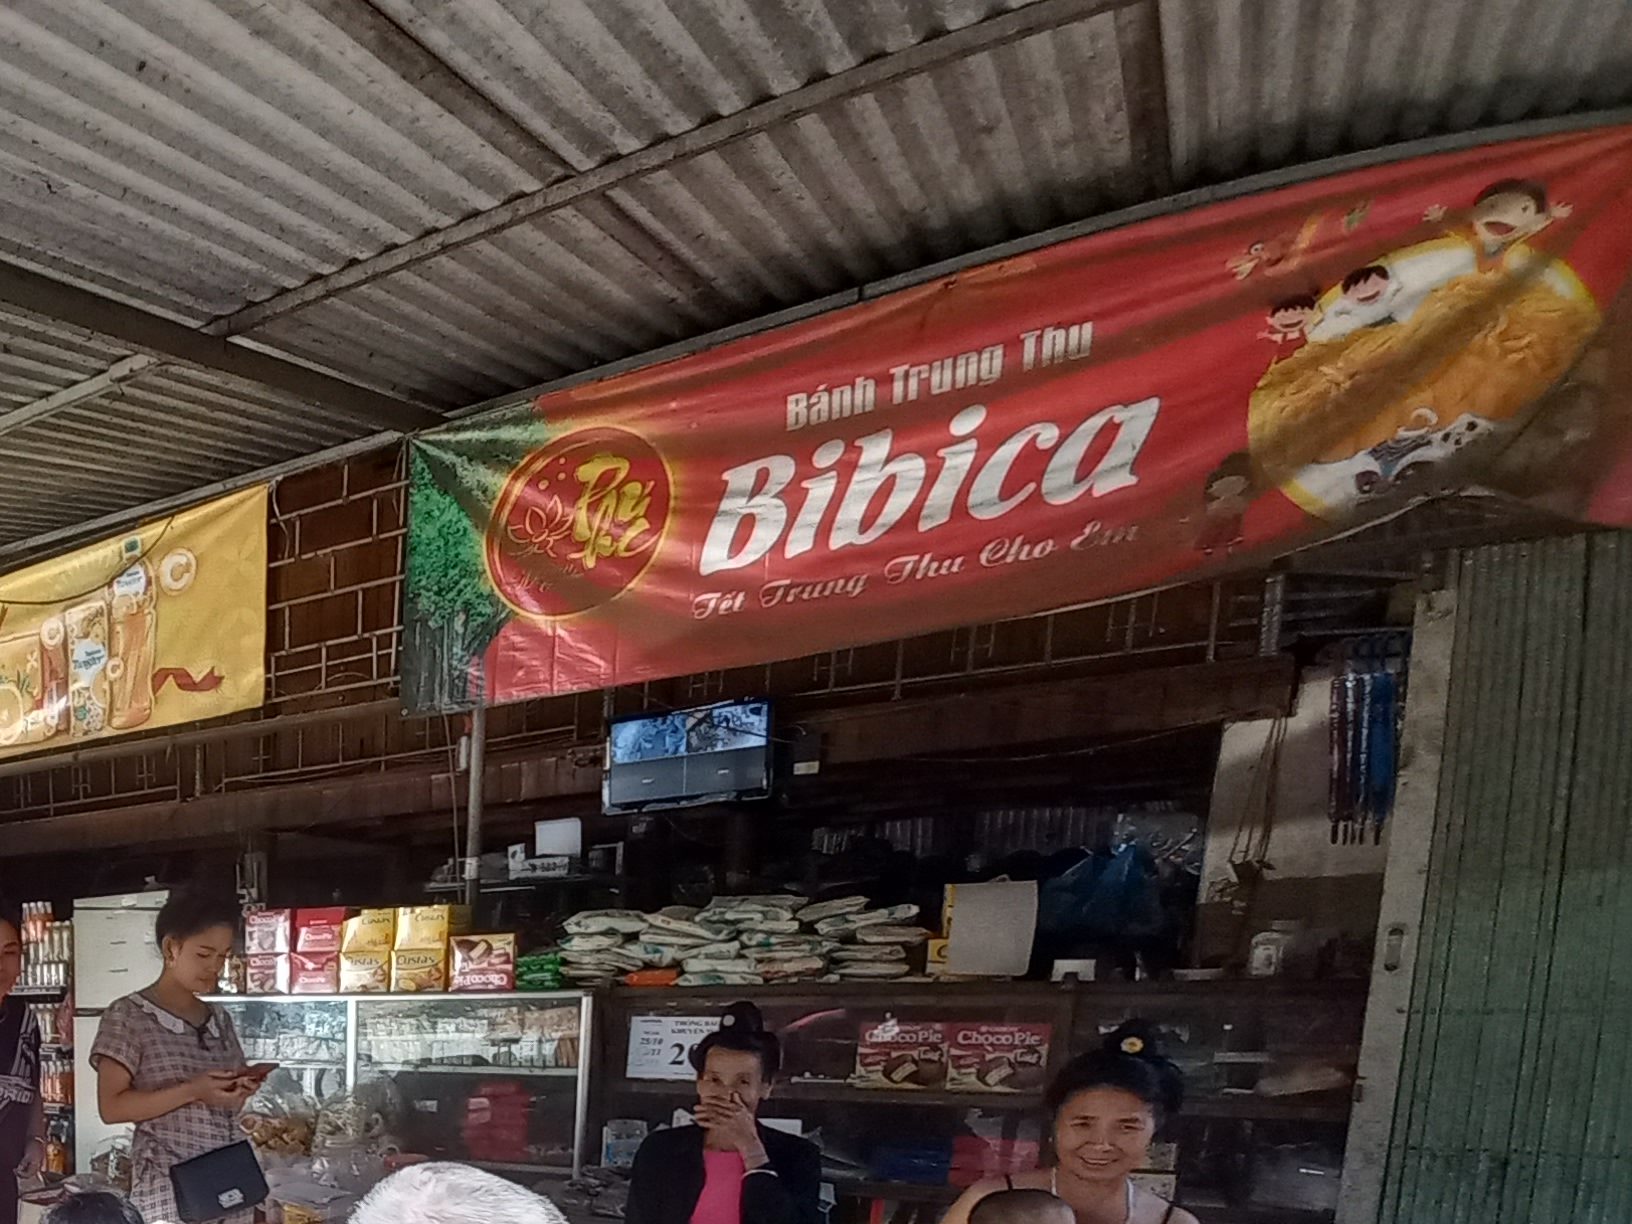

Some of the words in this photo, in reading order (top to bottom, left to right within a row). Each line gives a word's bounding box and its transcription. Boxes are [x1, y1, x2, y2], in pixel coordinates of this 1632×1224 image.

[785, 377, 876, 432] Bánh
[888, 341, 1006, 404] Trung
[1018, 319, 1095, 371] Thu
[698, 396, 1162, 579] Bibica
[759, 571, 870, 608] Trung
[884, 553, 966, 585] Thu
[979, 533, 1059, 569] Cho
